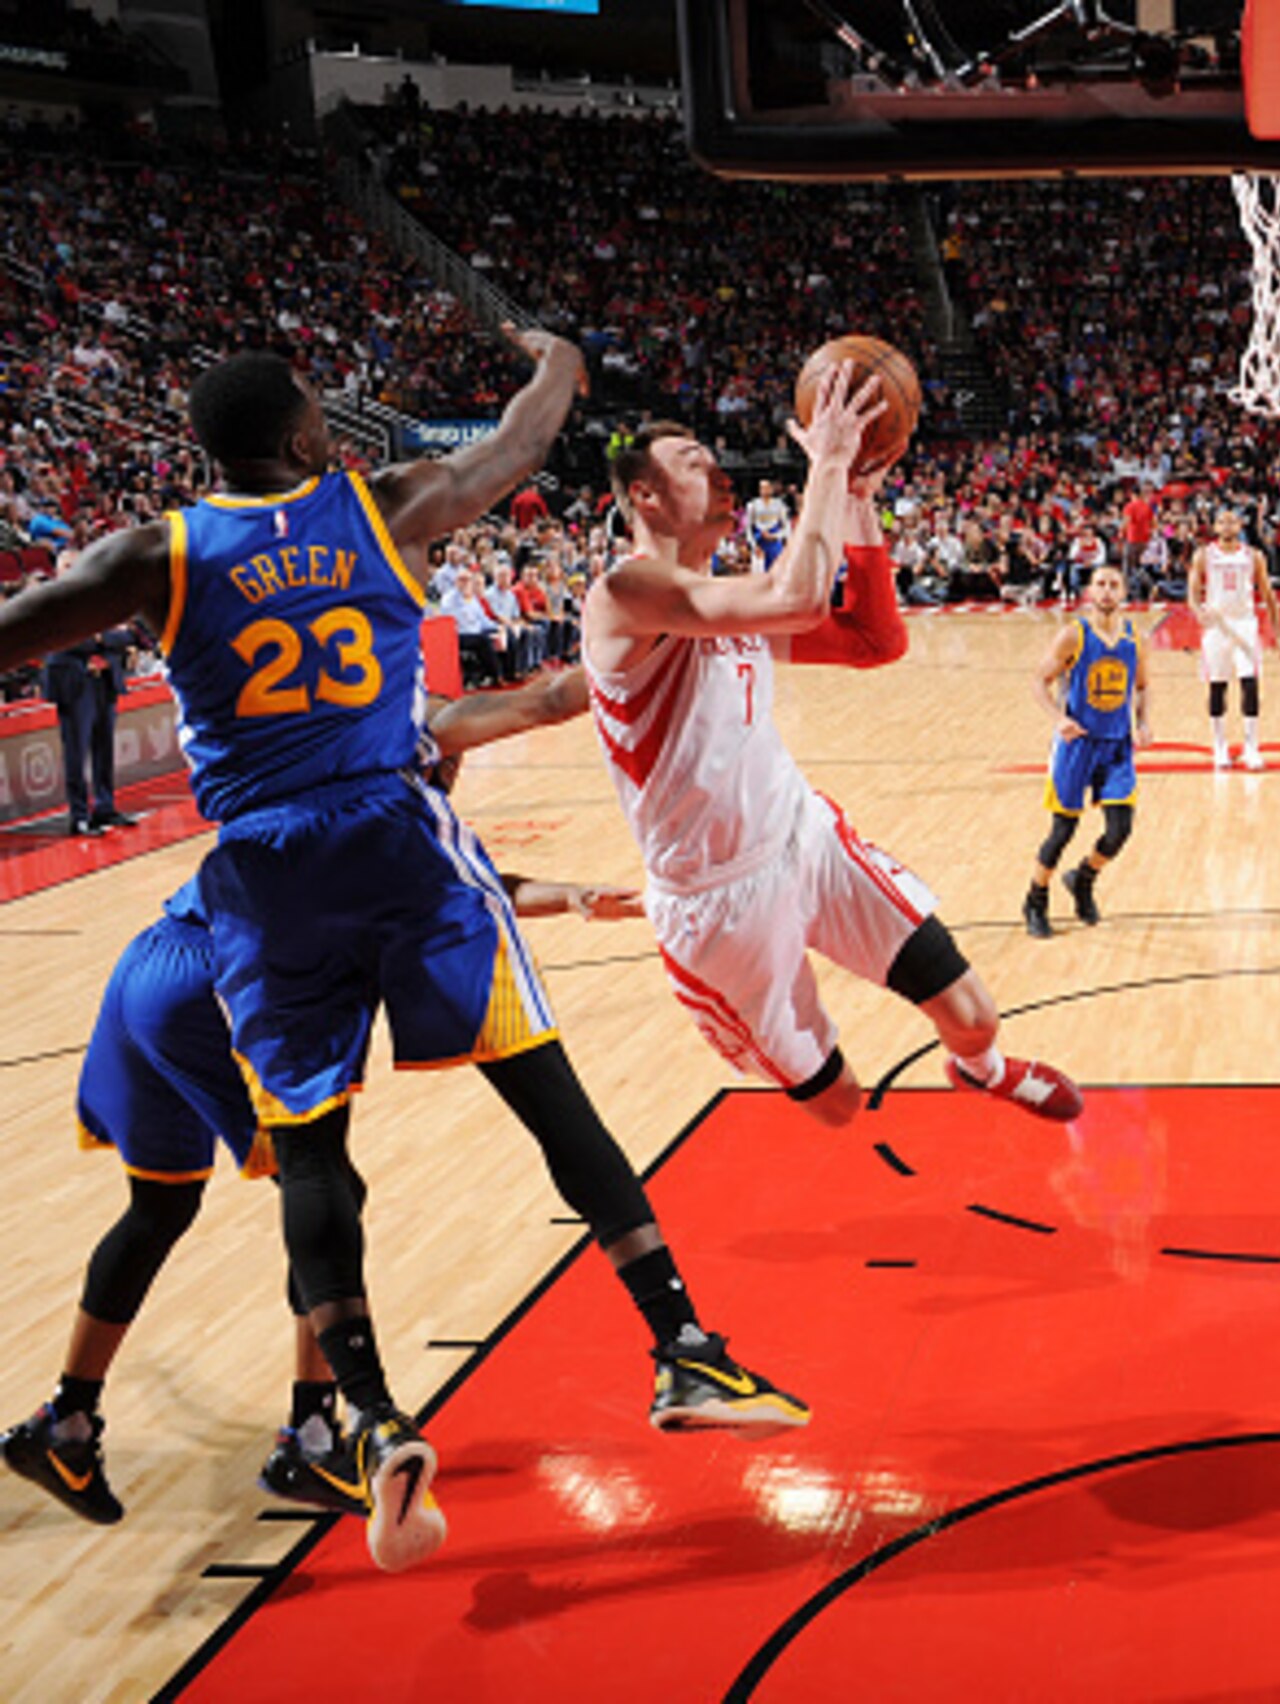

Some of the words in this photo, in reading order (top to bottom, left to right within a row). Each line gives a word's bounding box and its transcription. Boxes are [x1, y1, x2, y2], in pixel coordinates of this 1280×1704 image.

[229, 545, 358, 604] GREEN
[230, 606, 384, 719] 23
[736, 663, 756, 726] 7
